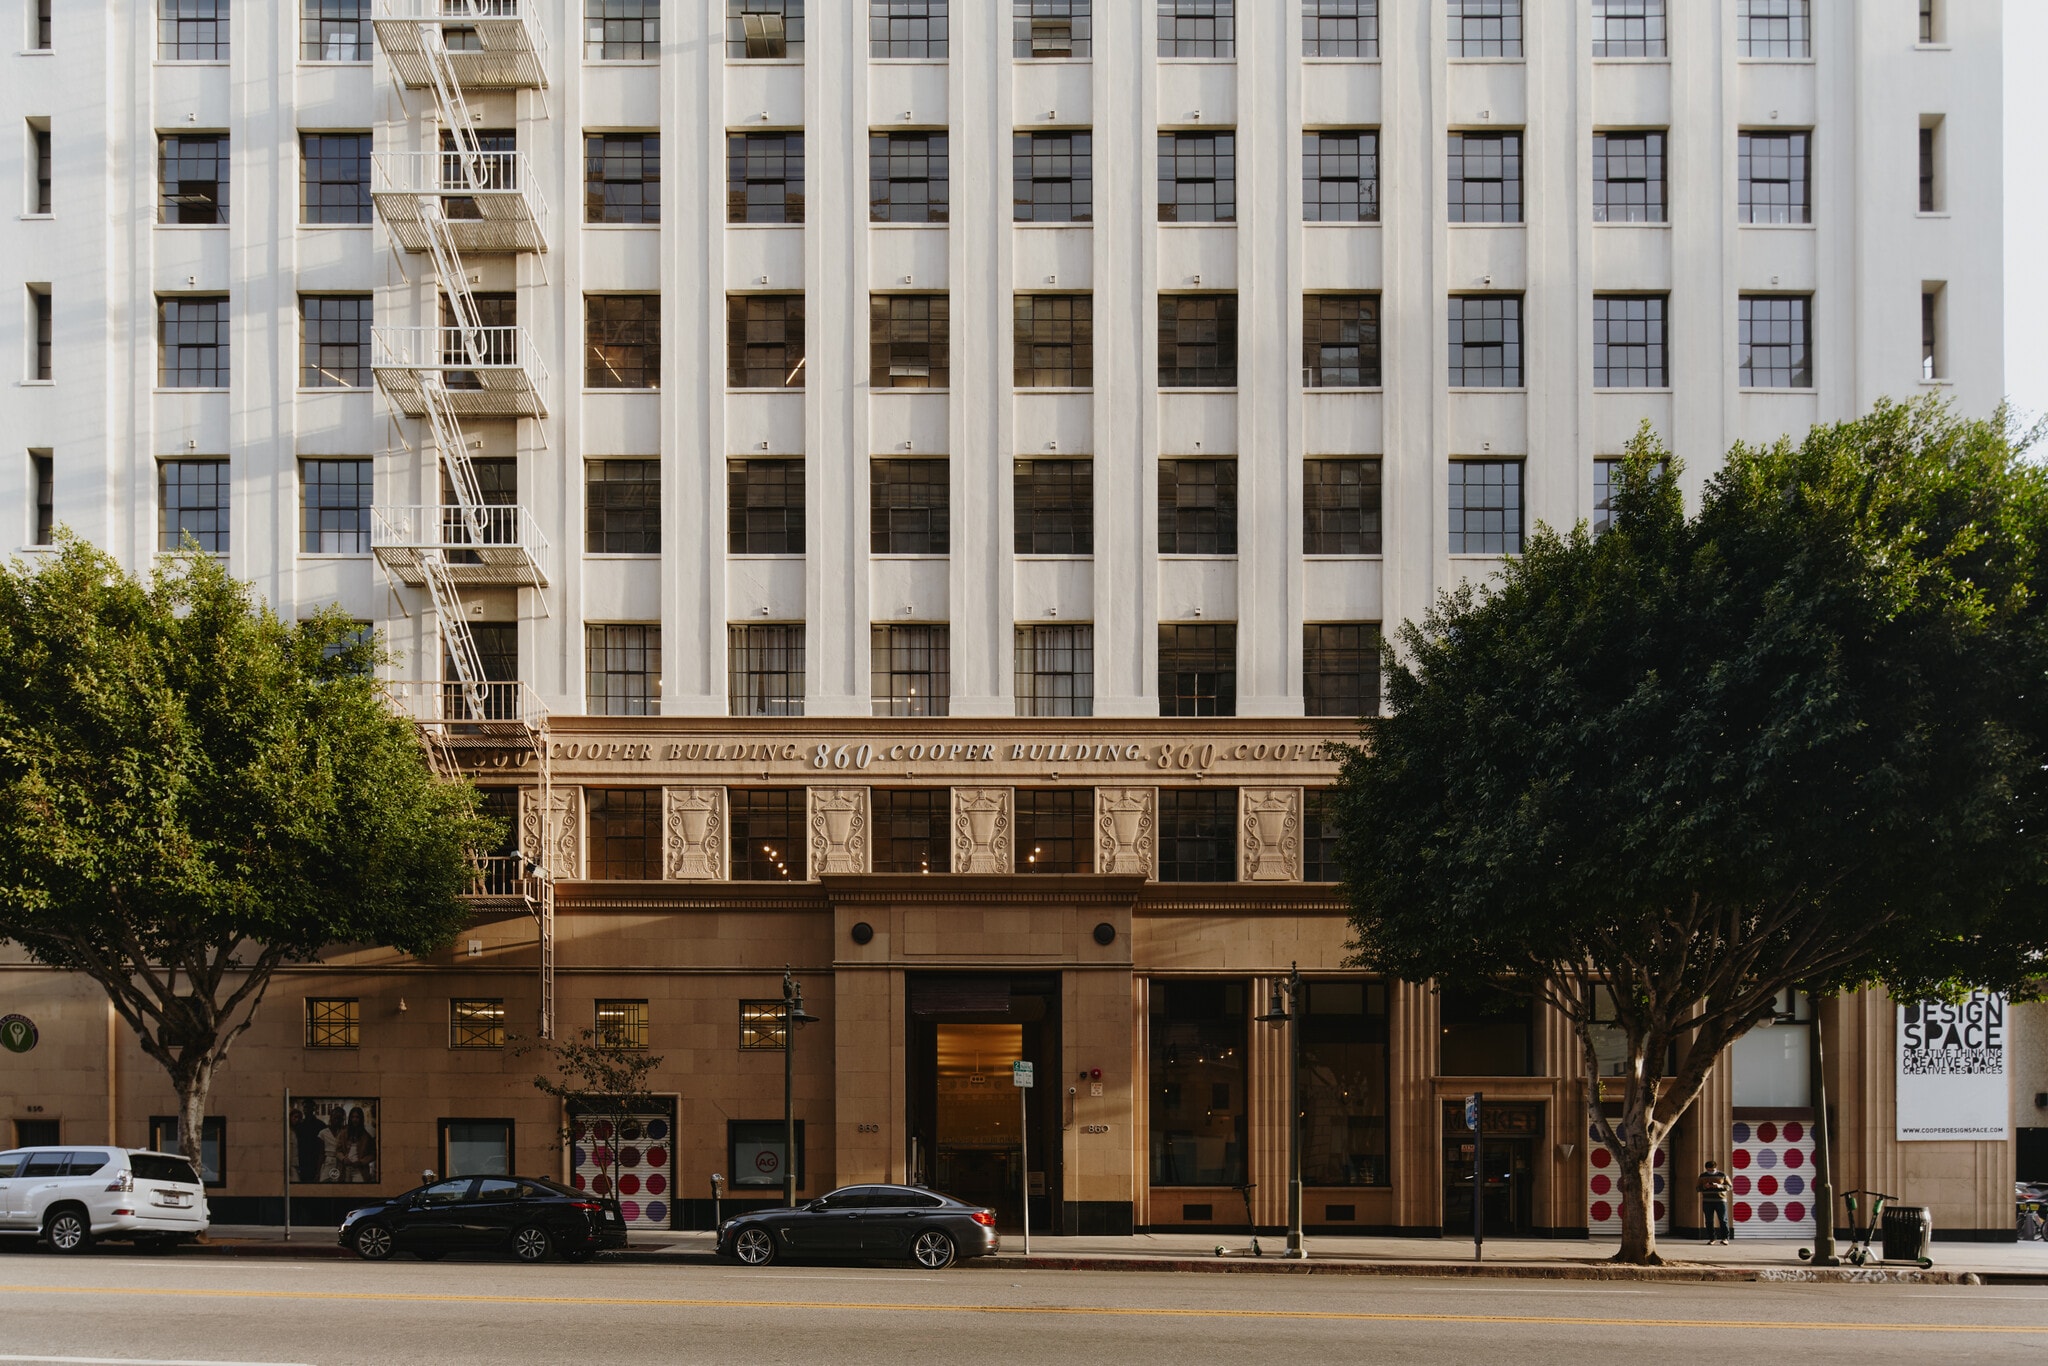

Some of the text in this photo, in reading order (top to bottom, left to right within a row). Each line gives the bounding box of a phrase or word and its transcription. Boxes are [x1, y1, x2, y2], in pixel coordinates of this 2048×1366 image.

[550, 743, 653, 761] COOPER
[667, 743, 797, 761] BUILDING
[813, 743, 872, 769] 860
[890, 743, 996, 761] COOPER
[1010, 743, 1141, 761] BUILDING
[1157, 743, 1215, 769] 860
[1904, 1001, 2002, 1026] DESIGN
[1903, 1024, 2002, 1049] SPACE
[1903, 1049, 2002, 1058] CREATIVE THINKING
[1903, 1056, 2002, 1068] CREATIVE SPACE
[1903, 1066, 2003, 1075] CREATIVE RESOURCES
[858, 1123, 880, 1132] 860
[1088, 1124, 1110, 1133] 860
